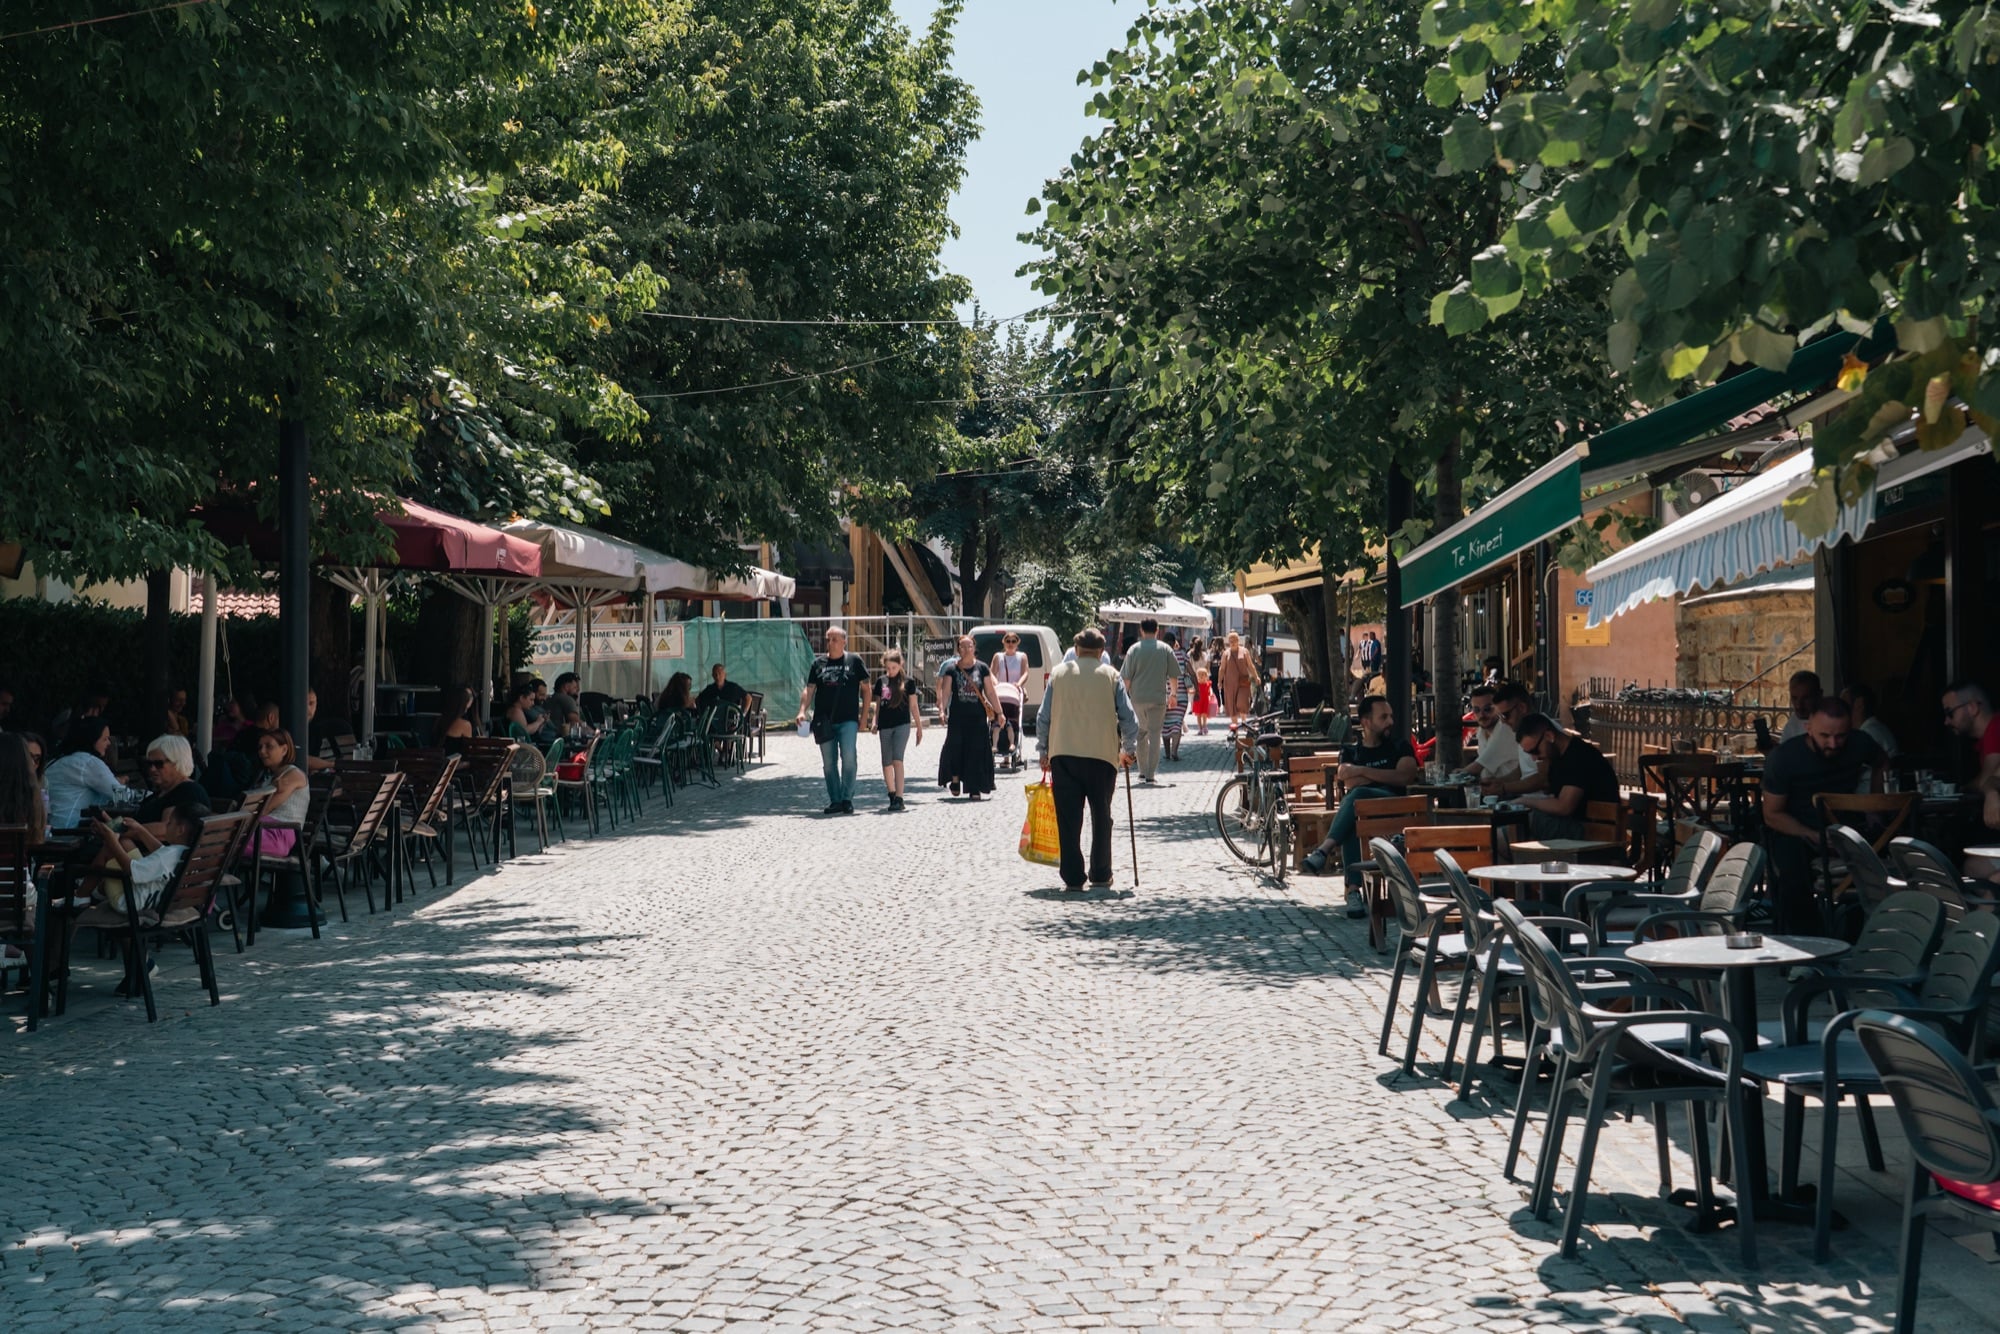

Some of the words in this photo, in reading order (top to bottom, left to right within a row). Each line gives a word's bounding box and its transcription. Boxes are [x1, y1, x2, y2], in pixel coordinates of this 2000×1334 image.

[1451, 546, 1465, 568] Te
[1468, 526, 1503, 561] Kinezi
[557, 631, 576, 639] NGA
